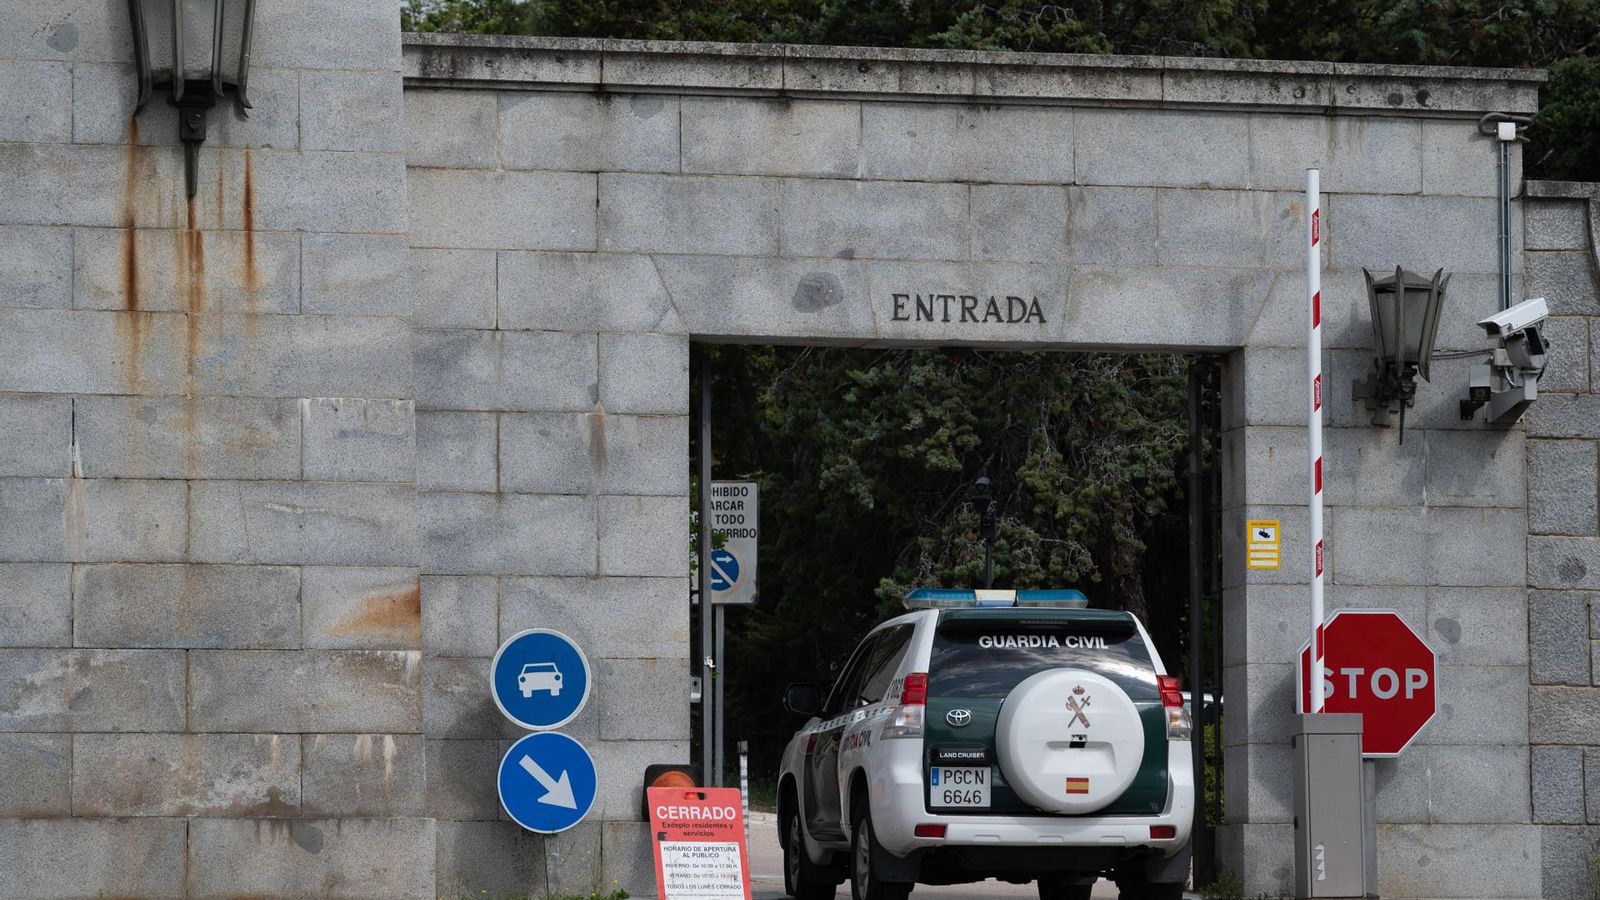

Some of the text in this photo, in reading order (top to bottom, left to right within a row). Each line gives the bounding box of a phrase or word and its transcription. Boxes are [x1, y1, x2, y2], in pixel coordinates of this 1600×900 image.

[891, 293, 1047, 323] ENTRADA
[712, 487, 748, 497] HIBIDO
[711, 500, 744, 511] ARCAR
[715, 514, 744, 524] TODO
[979, 635, 1109, 649] GUARDIA CIVIL
[943, 769, 984, 785] PGCN
[943, 789, 982, 804] 6646
[656, 806, 736, 820] CERRADO
